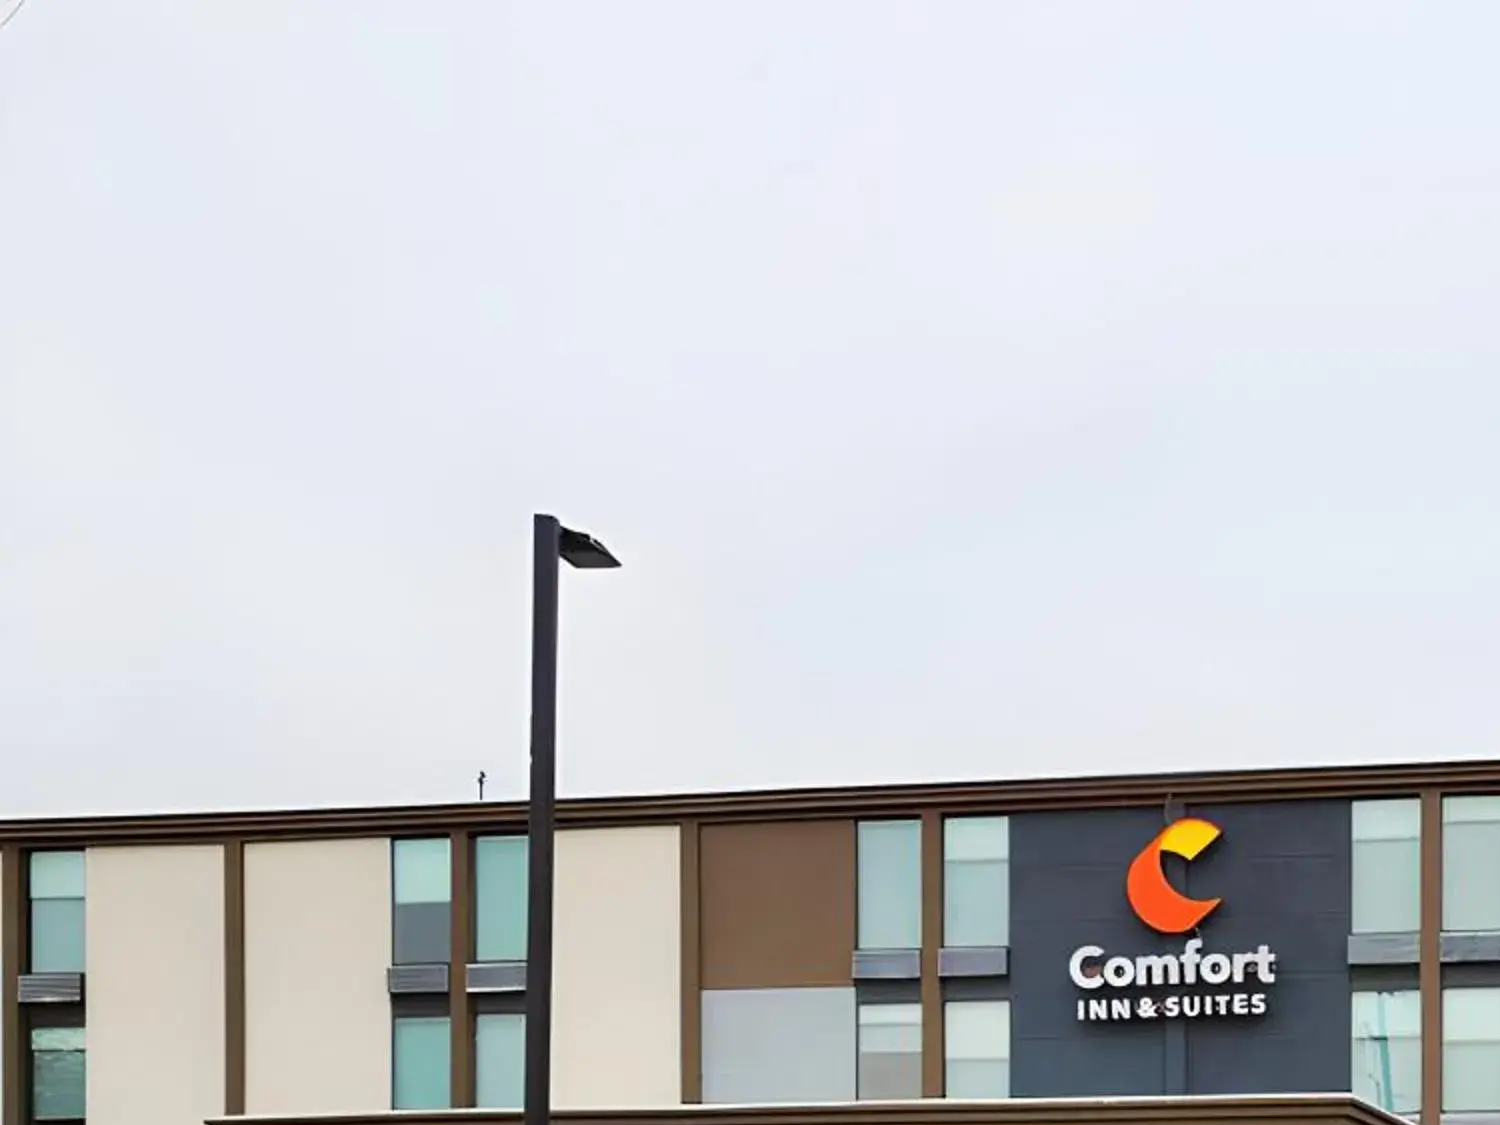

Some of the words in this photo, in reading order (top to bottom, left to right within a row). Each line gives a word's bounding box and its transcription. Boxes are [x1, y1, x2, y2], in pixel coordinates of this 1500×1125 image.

[1069, 937, 1277, 990] Comfort
[1077, 998, 1131, 1021] INN
[1163, 993, 1267, 1018] SUITES
